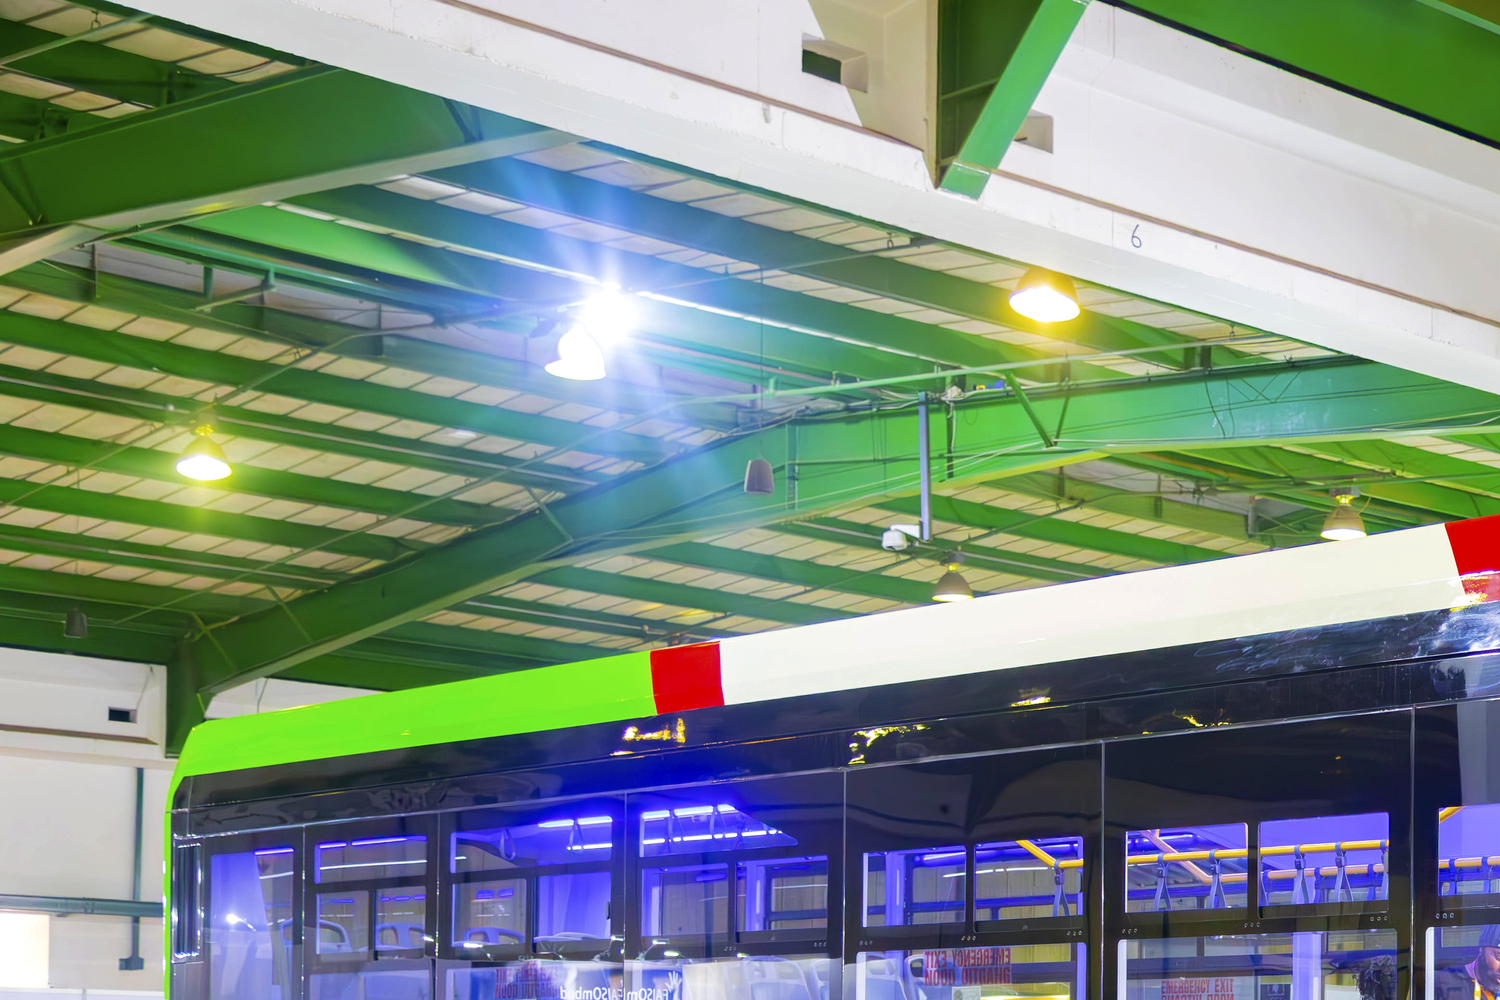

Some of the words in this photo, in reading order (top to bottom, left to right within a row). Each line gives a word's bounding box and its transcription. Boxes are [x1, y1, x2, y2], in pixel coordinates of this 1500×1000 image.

[1131, 224, 1142, 248] 6
[924, 969, 956, 987] NOOD
[961, 966, 1011, 985] UITGANG
[1161, 979, 1211, 994] EMERGENCY
[1214, 978, 1234, 993] EXIT
